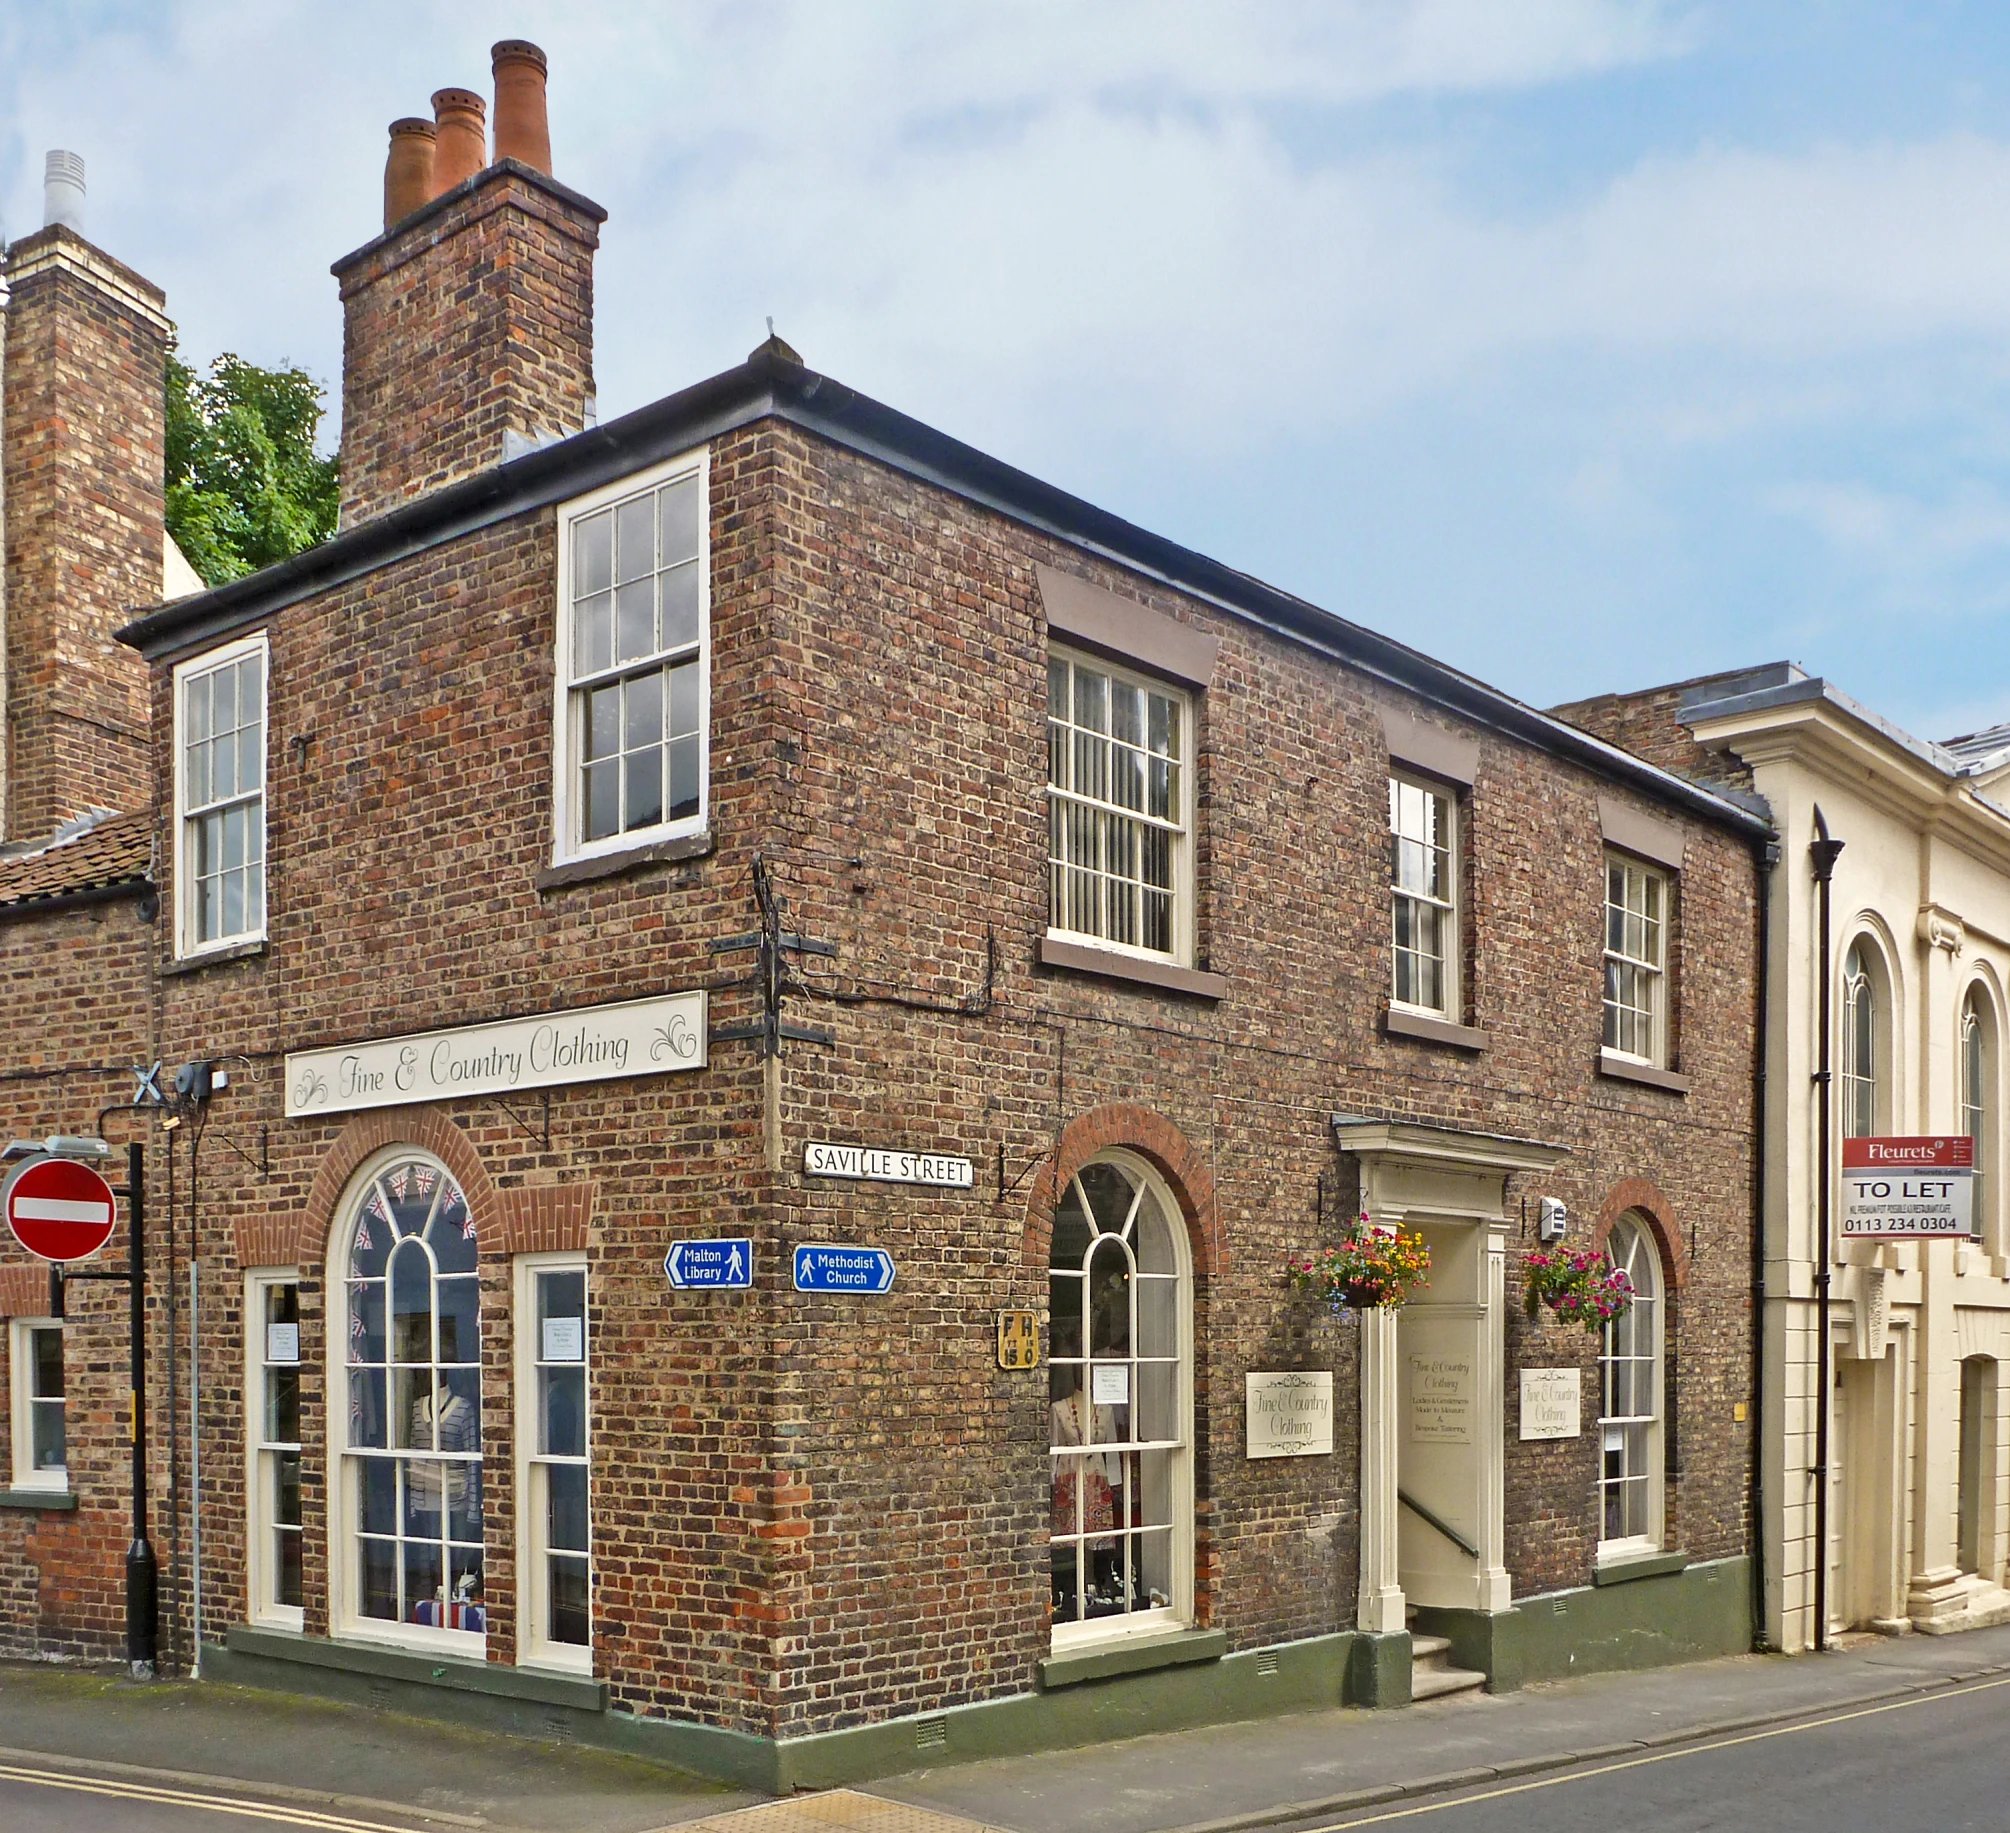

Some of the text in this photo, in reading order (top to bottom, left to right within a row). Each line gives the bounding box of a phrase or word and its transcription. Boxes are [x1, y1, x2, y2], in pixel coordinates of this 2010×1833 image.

[340, 1024, 629, 1099] Fine & Country Clothing
[1868, 1143, 1936, 1159] Fleurets
[814, 1148, 966, 1182] SAVILLE STREET
[1853, 1182, 1954, 1198] TO LET
[1845, 1217, 1957, 1232] 0113 234 0304
[684, 1248, 721, 1263] Malton
[817, 1254, 875, 1270] Methodist
[684, 1266, 721, 1281] Library
[826, 1271, 867, 1285] Church
[1021, 1316, 1033, 1337] H
[1004, 1349, 1018, 1366] 15
[1424, 1375, 1459, 1392] Clothing
[1252, 1389, 1277, 1414] Fine
[1288, 1389, 1328, 1419] Country
[1535, 1402, 1566, 1426] Clothing
[1270, 1413, 1312, 1440] Clothing
